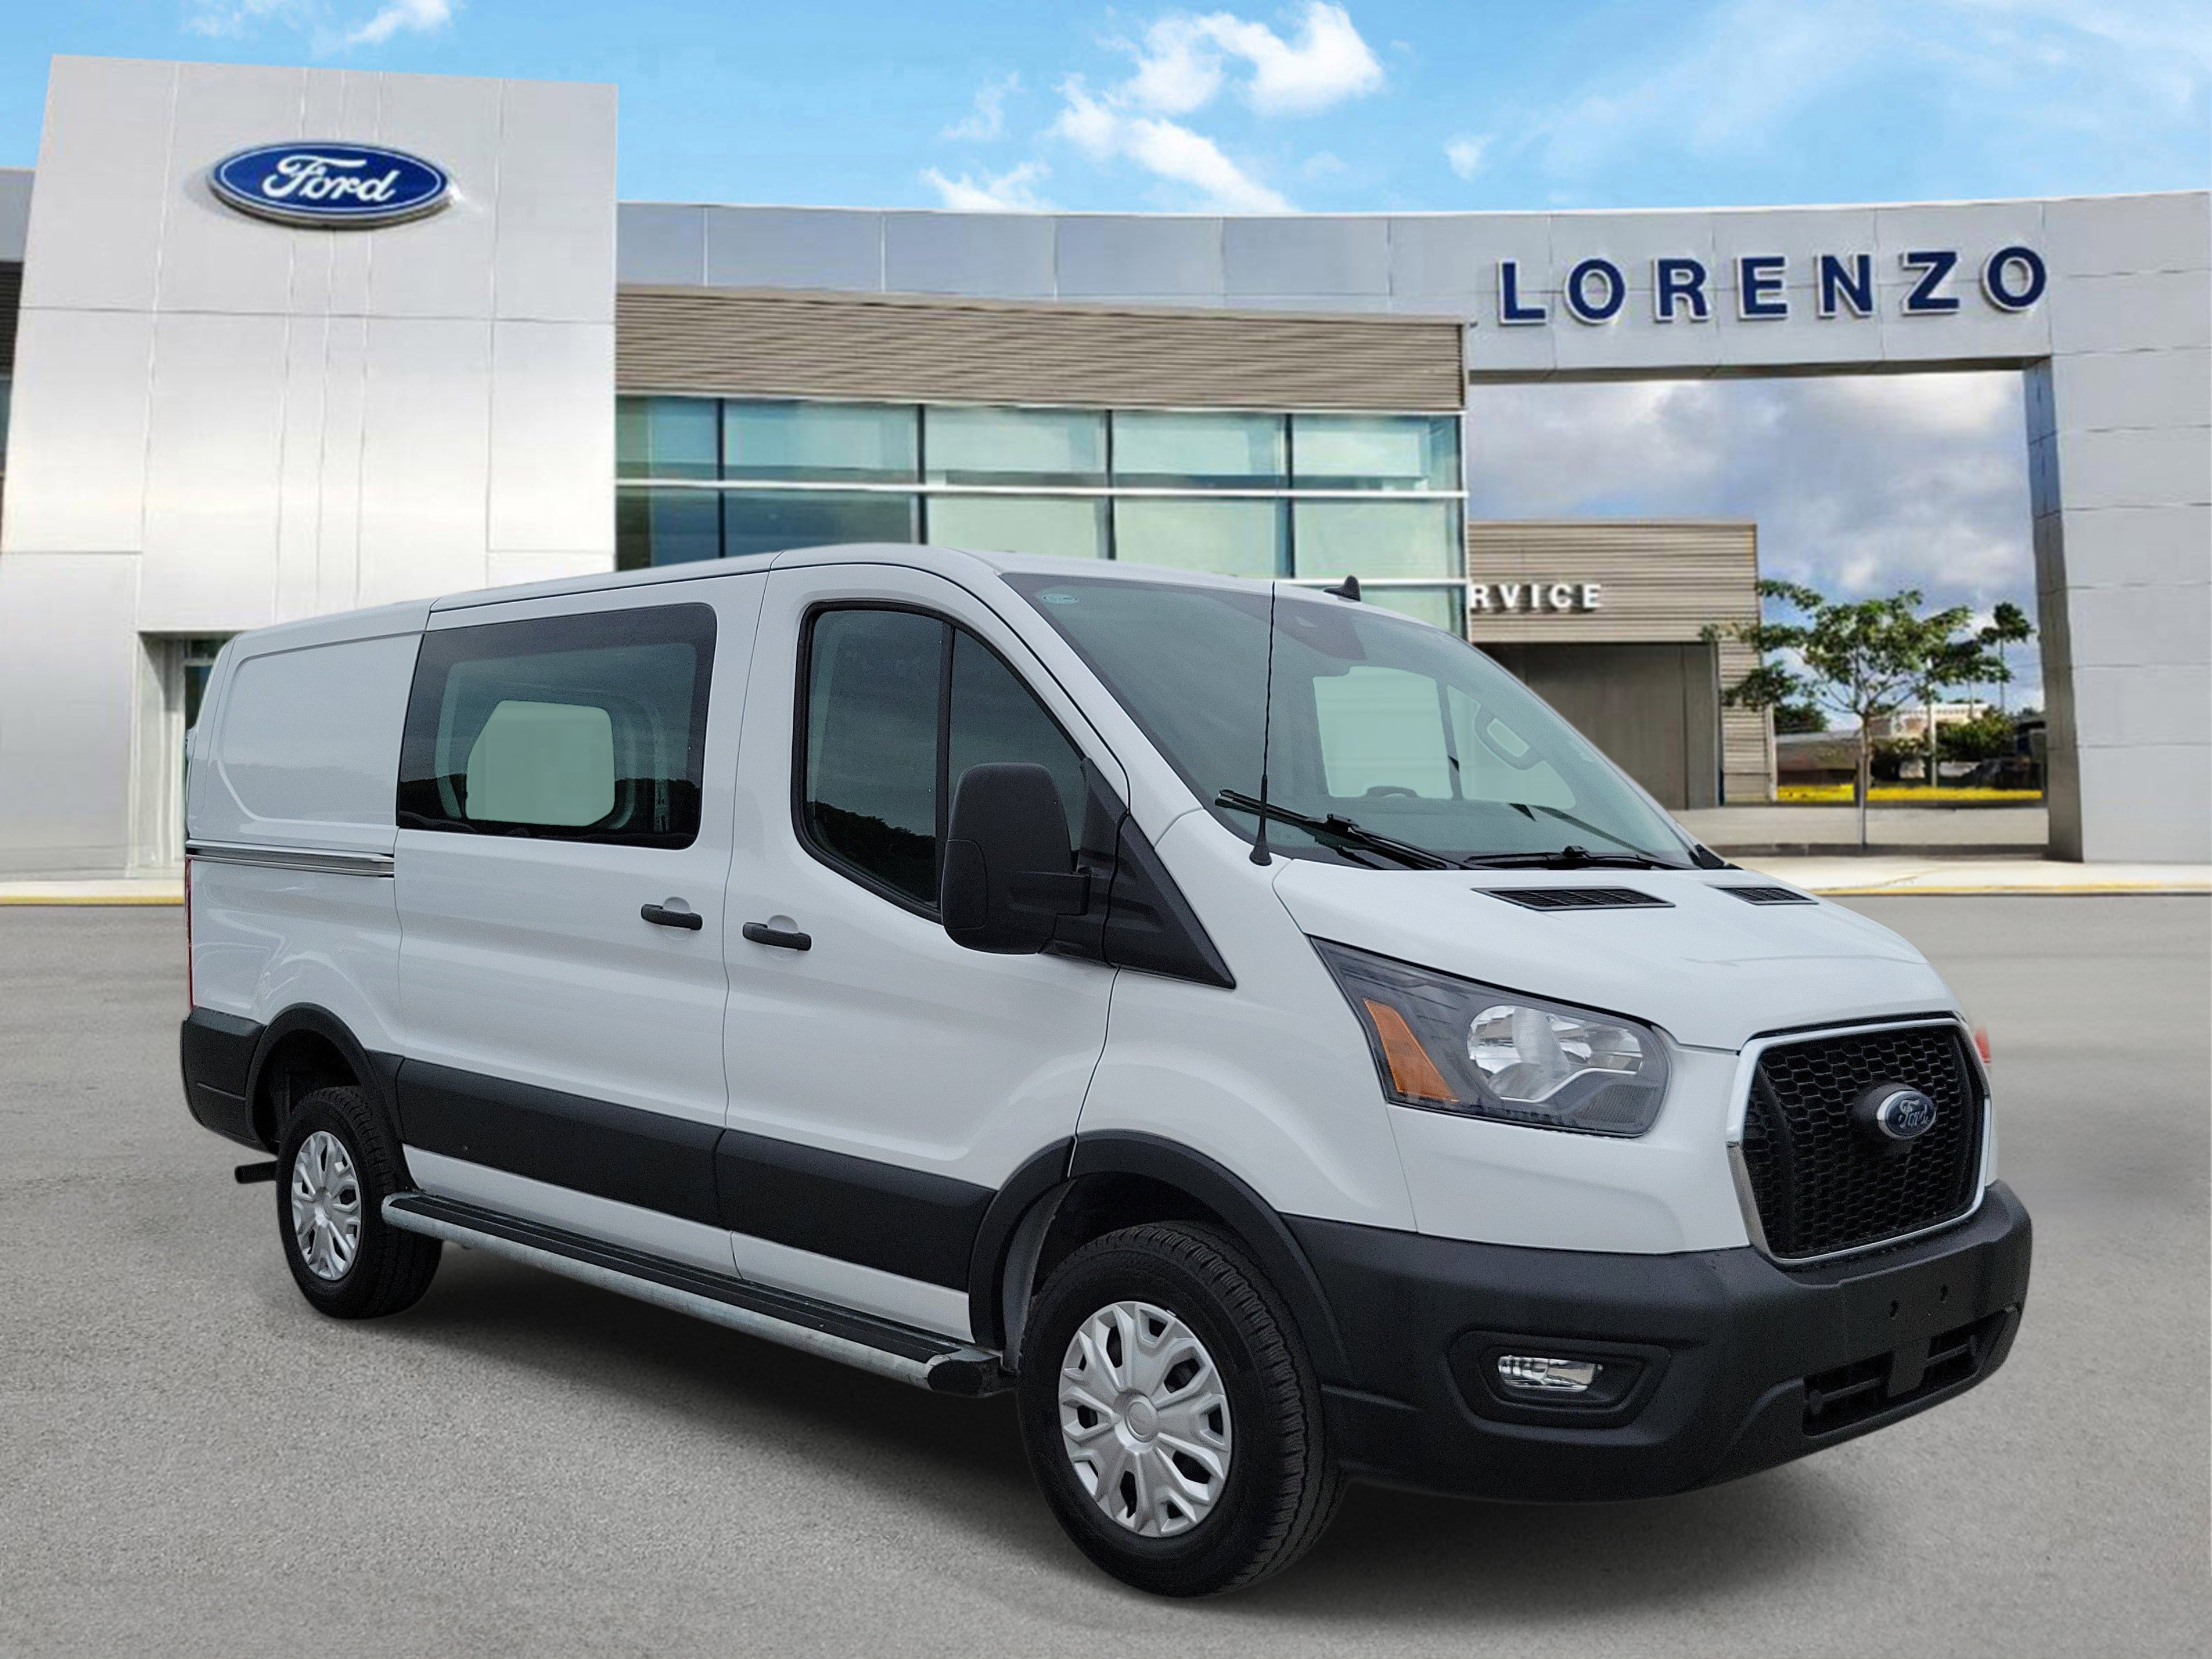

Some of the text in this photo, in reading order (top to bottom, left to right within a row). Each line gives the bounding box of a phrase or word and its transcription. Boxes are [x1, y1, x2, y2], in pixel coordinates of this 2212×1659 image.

[262, 154, 401, 202] Ford
[1498, 245, 2048, 325] LORENZO
[1898, 1099, 1929, 1128] Ford
